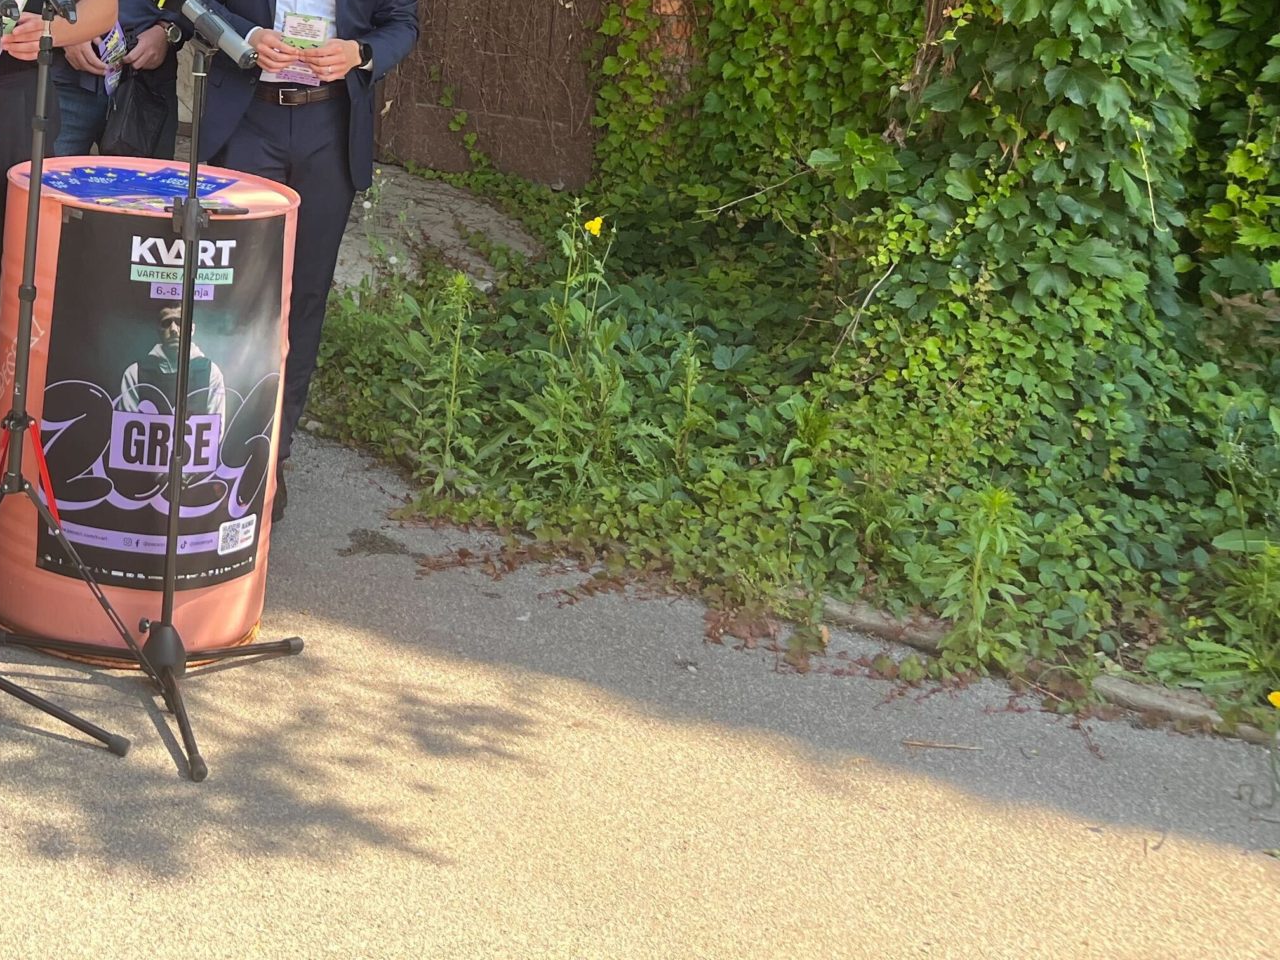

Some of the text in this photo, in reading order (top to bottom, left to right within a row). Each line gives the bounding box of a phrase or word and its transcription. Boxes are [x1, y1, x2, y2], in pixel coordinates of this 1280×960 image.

[131, 235, 236, 266] KVART
[136, 269, 178, 280] VARTEKS
[195, 271, 229, 281] RAŽDIN
[156, 286, 180, 296] 6.-8.
